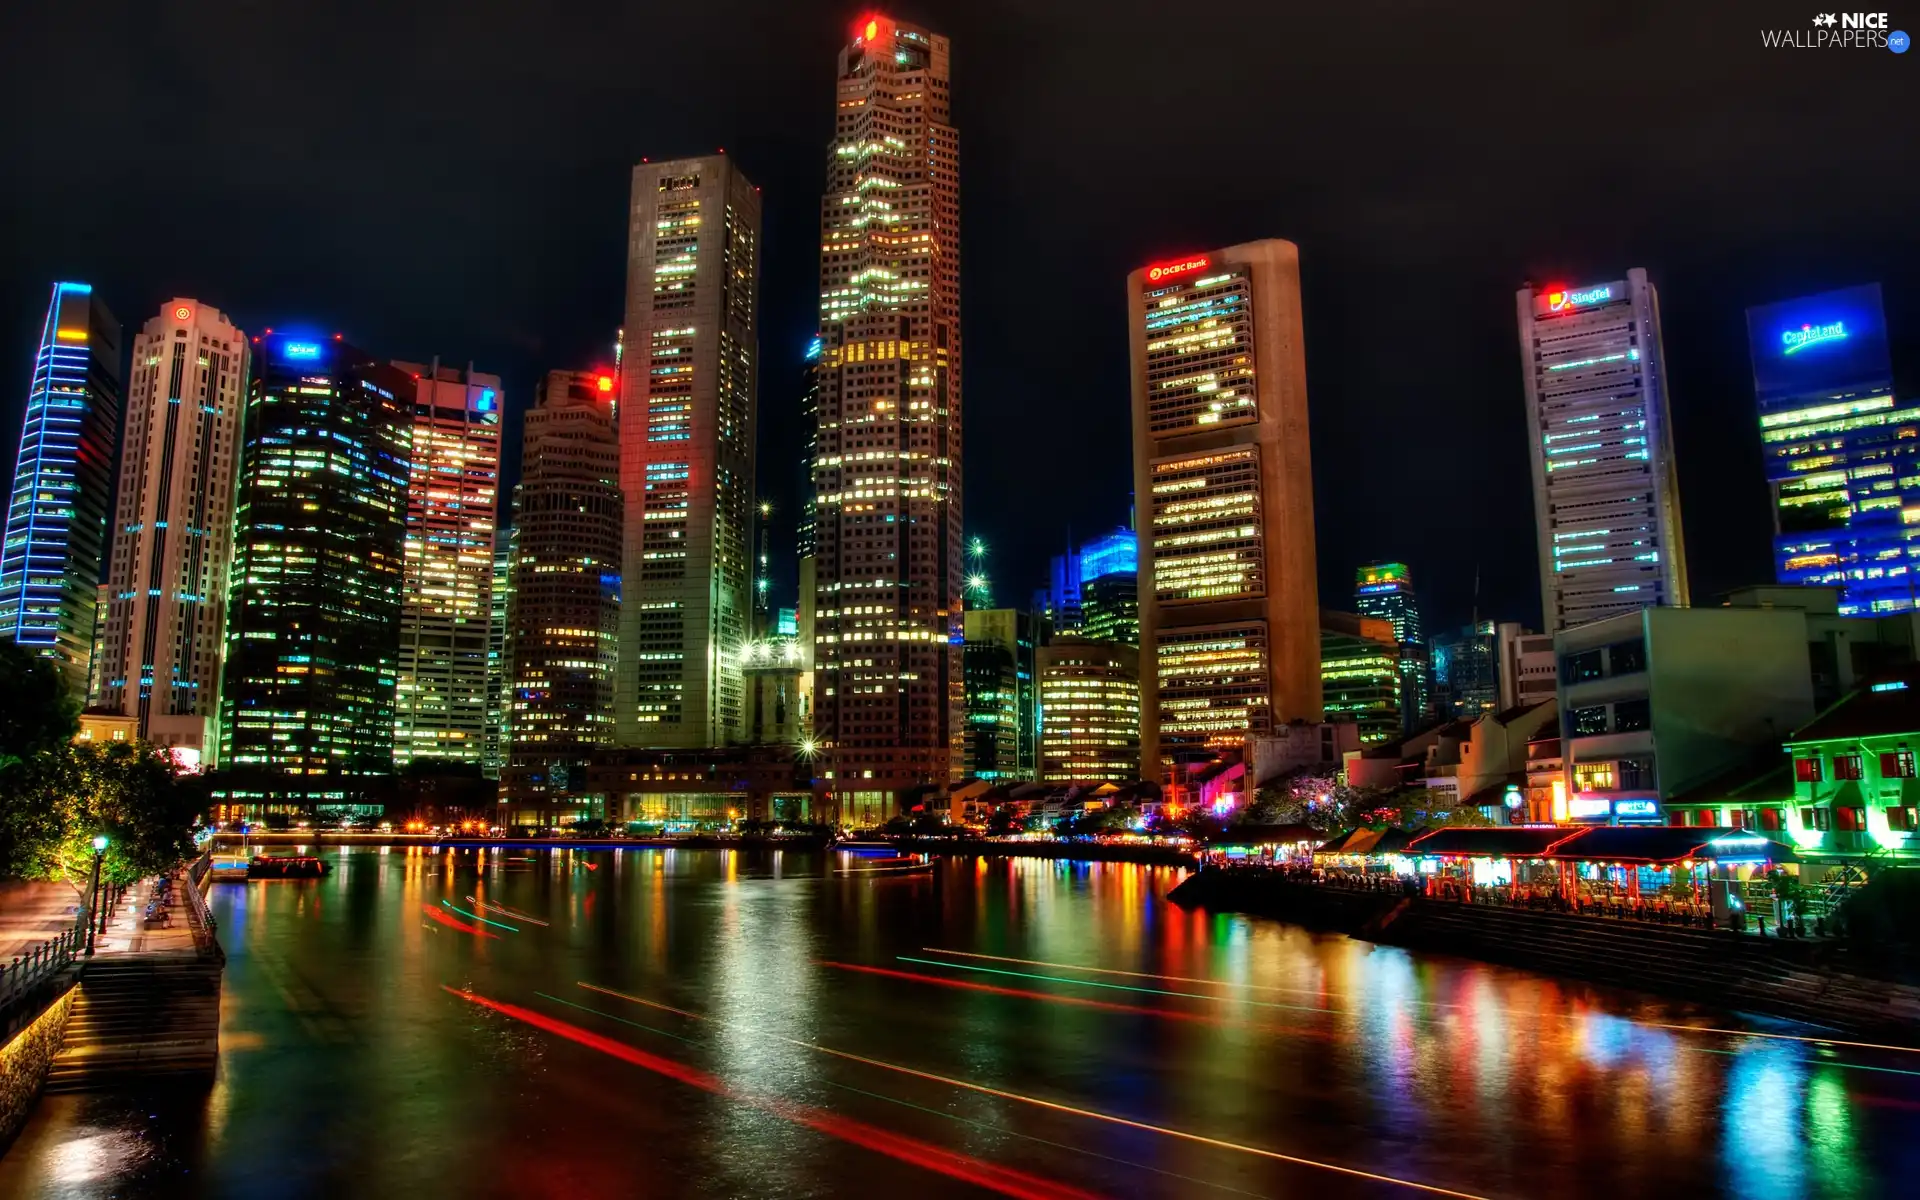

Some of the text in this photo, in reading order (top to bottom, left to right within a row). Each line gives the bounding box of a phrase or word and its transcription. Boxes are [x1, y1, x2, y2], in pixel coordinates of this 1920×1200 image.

[1162, 259, 1206, 275] OCBC Bank
[1571, 288, 1610, 304] SingTel
[1783, 321, 1843, 345] CapitaLand
